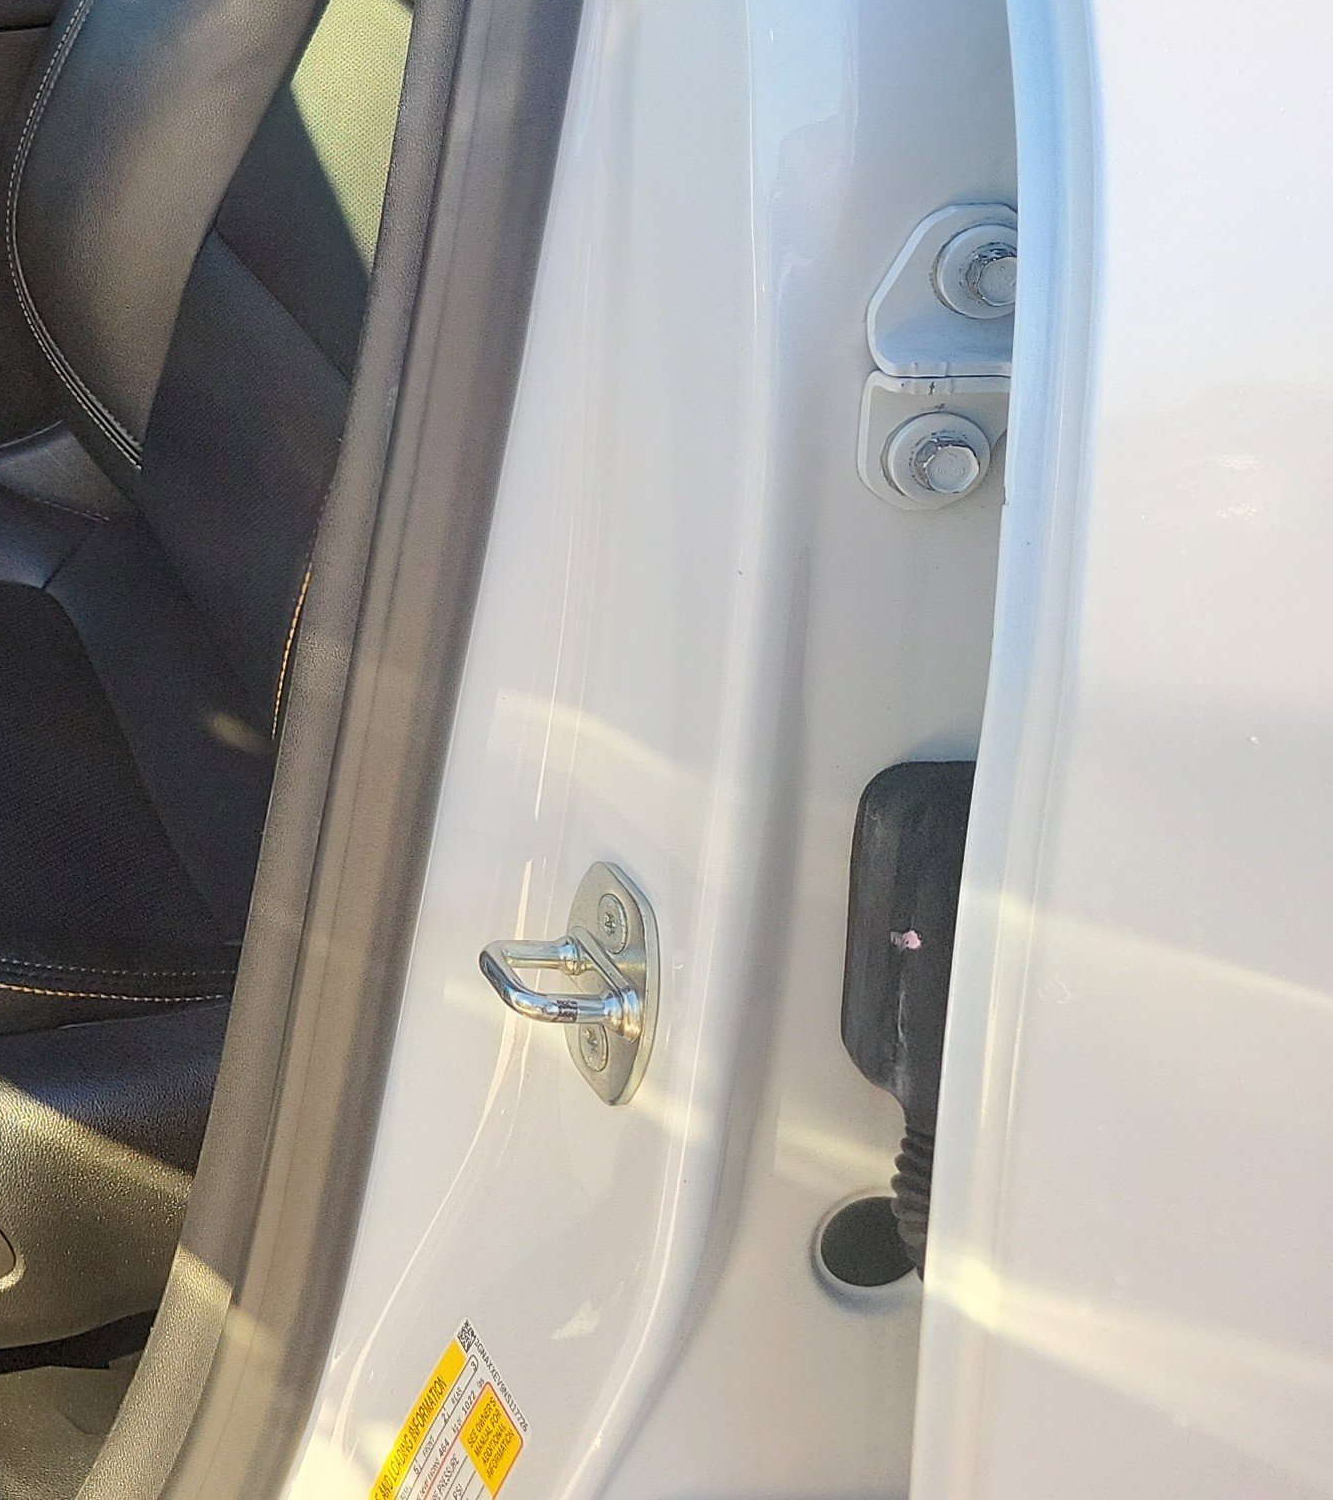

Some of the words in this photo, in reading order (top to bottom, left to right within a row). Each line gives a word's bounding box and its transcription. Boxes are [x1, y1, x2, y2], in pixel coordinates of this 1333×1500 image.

[462, 1390, 476, 1415] 1022
[389, 1434, 414, 1482] LOADING
[409, 1375, 447, 1443] INFORMATION
[467, 1429, 479, 1449] SEE
